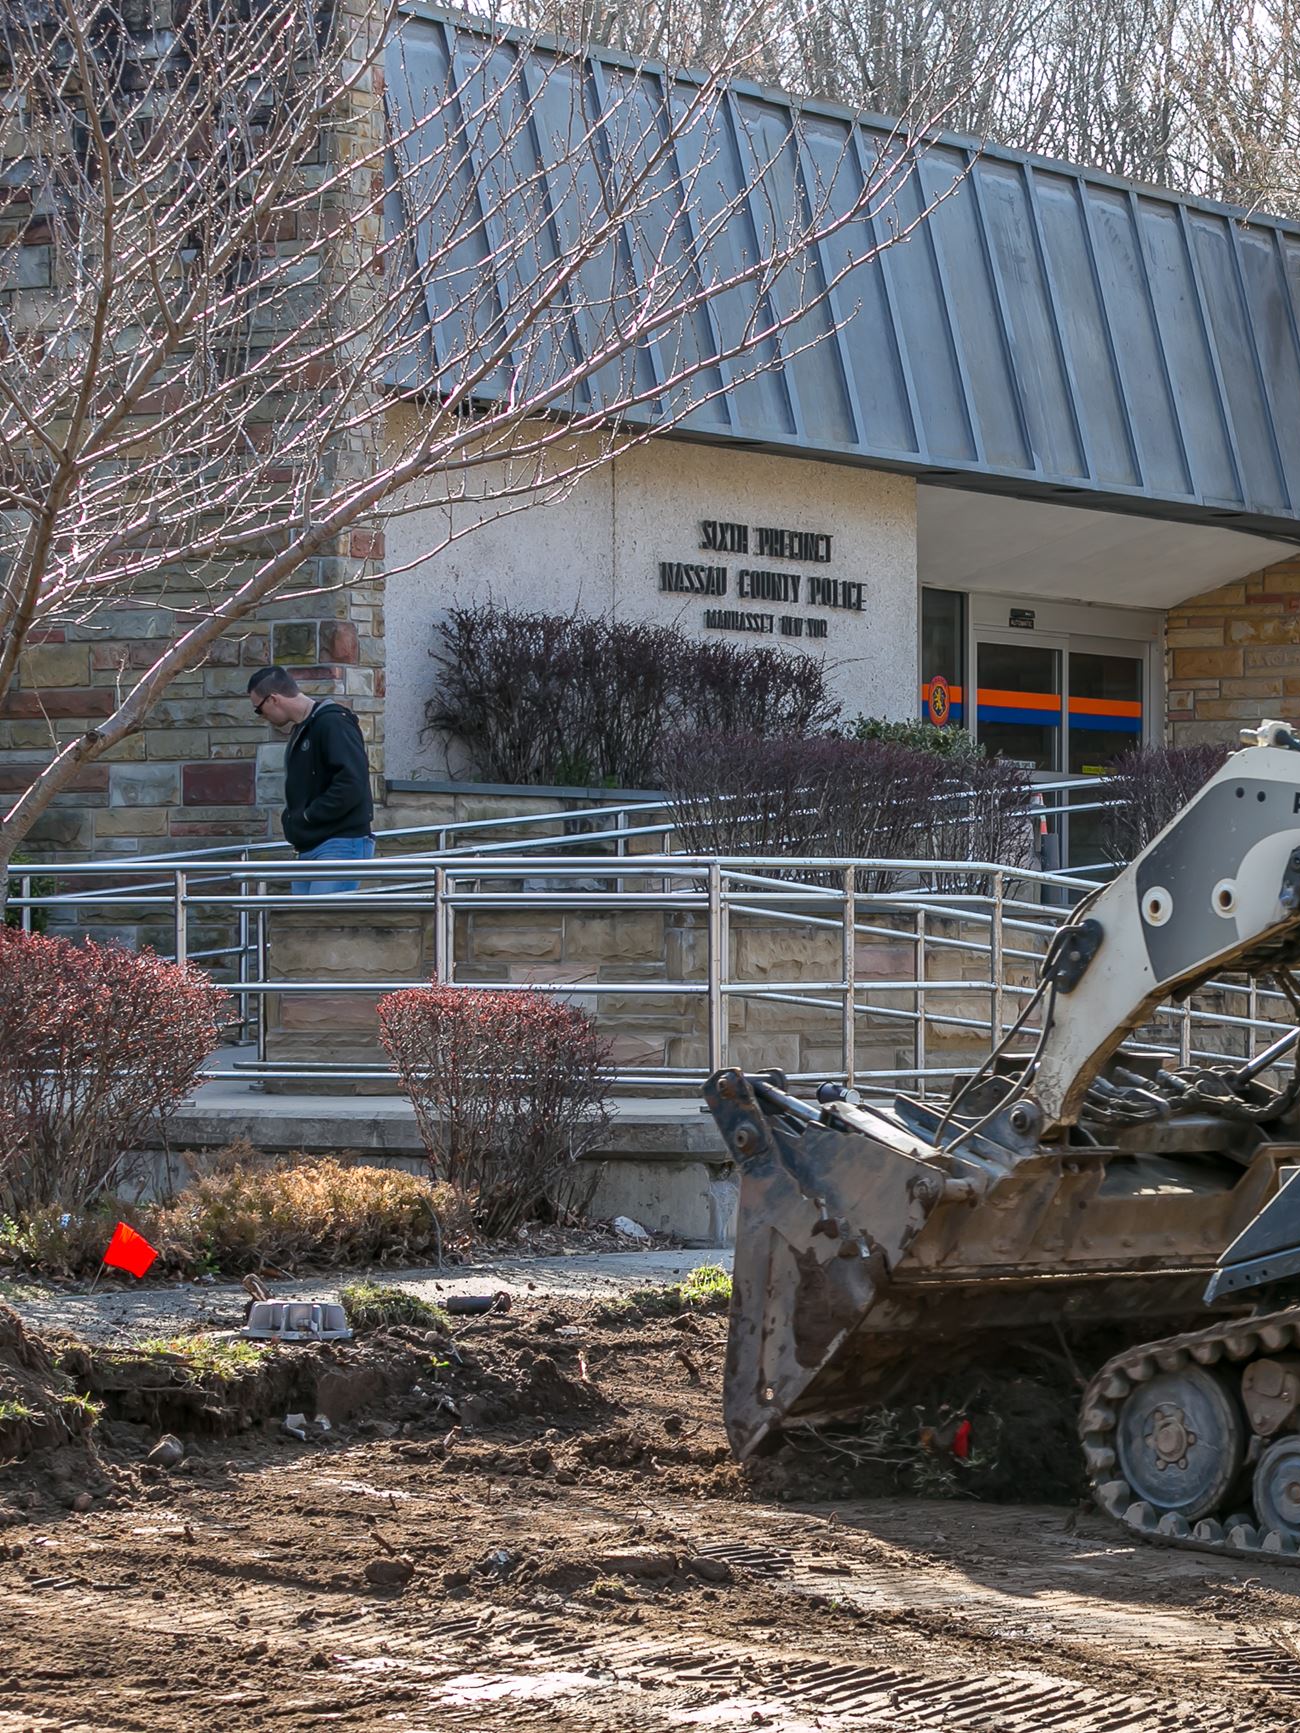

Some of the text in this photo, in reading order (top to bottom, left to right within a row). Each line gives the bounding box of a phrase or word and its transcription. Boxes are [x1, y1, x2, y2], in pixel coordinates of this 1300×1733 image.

[700, 520, 748, 554] SIXTH
[660, 562, 867, 611] NASSAU COUNTY POLICE
[703, 609, 775, 634] MANHASSET
[778, 615, 803, 637] NEW
